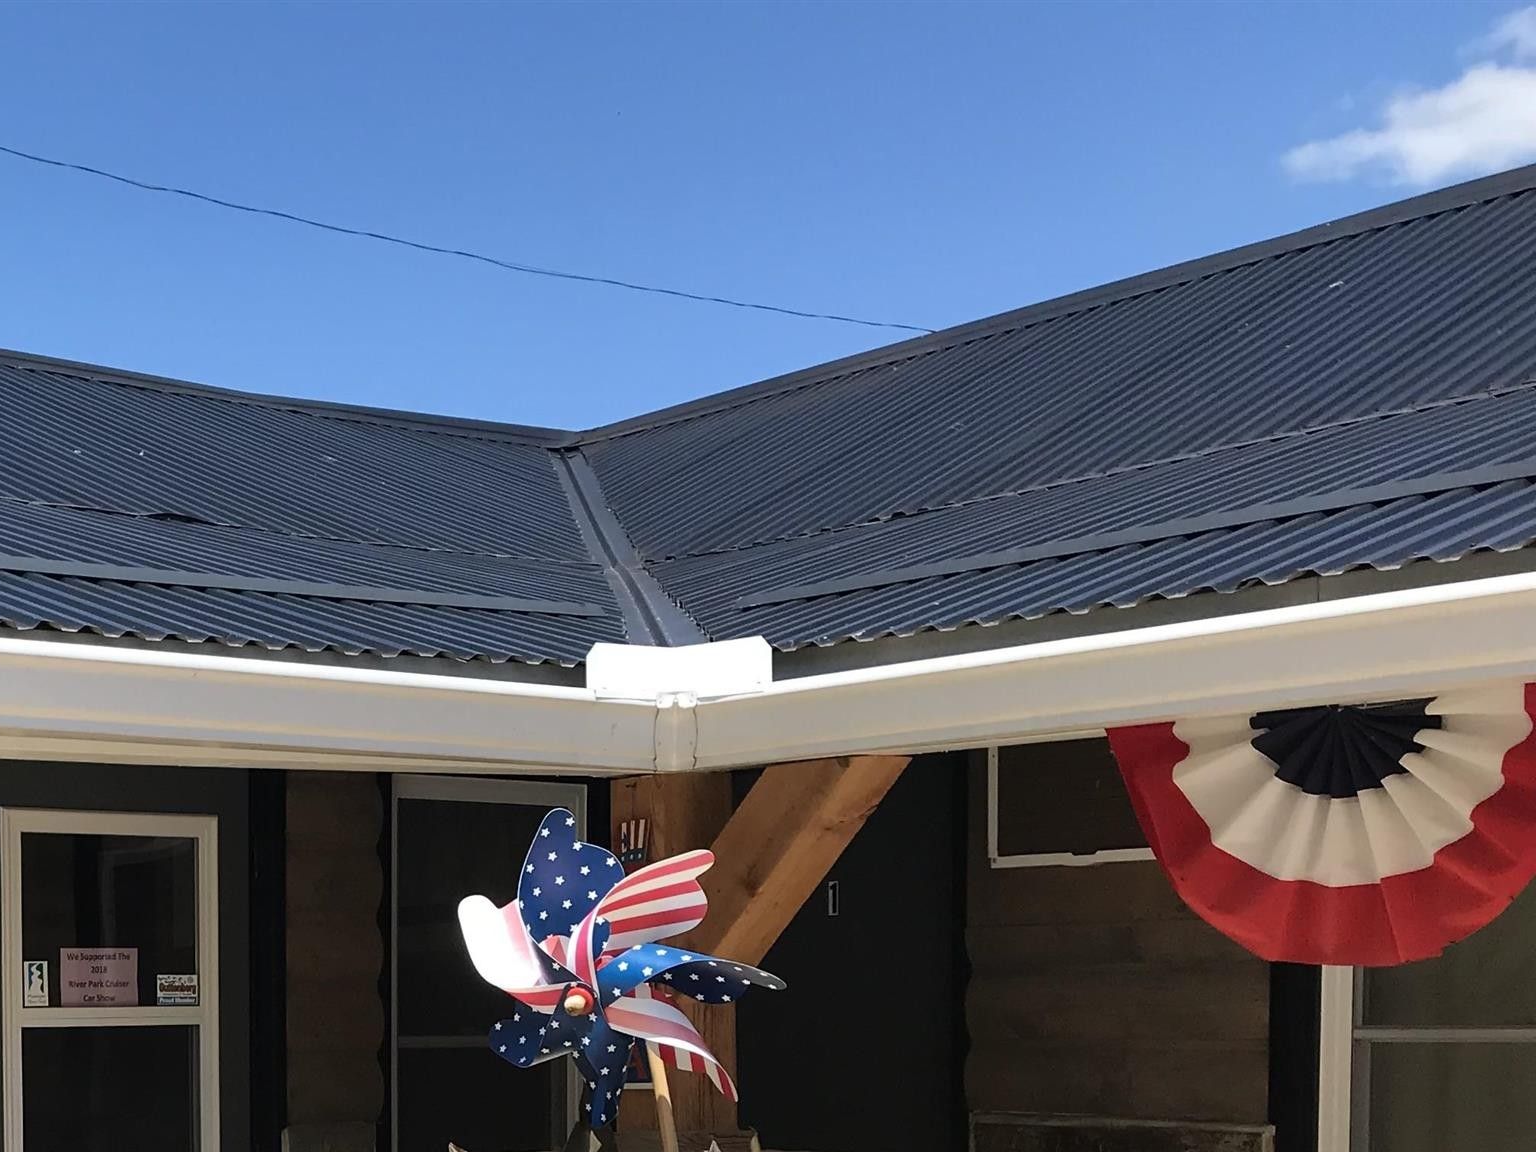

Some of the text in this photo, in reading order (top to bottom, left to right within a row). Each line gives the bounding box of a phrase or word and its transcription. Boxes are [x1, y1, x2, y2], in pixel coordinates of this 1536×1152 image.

[66, 952, 131, 962] We Supported The
[68, 980, 129, 988] River Park Cruiser
[83, 993, 116, 1002] Car Show
